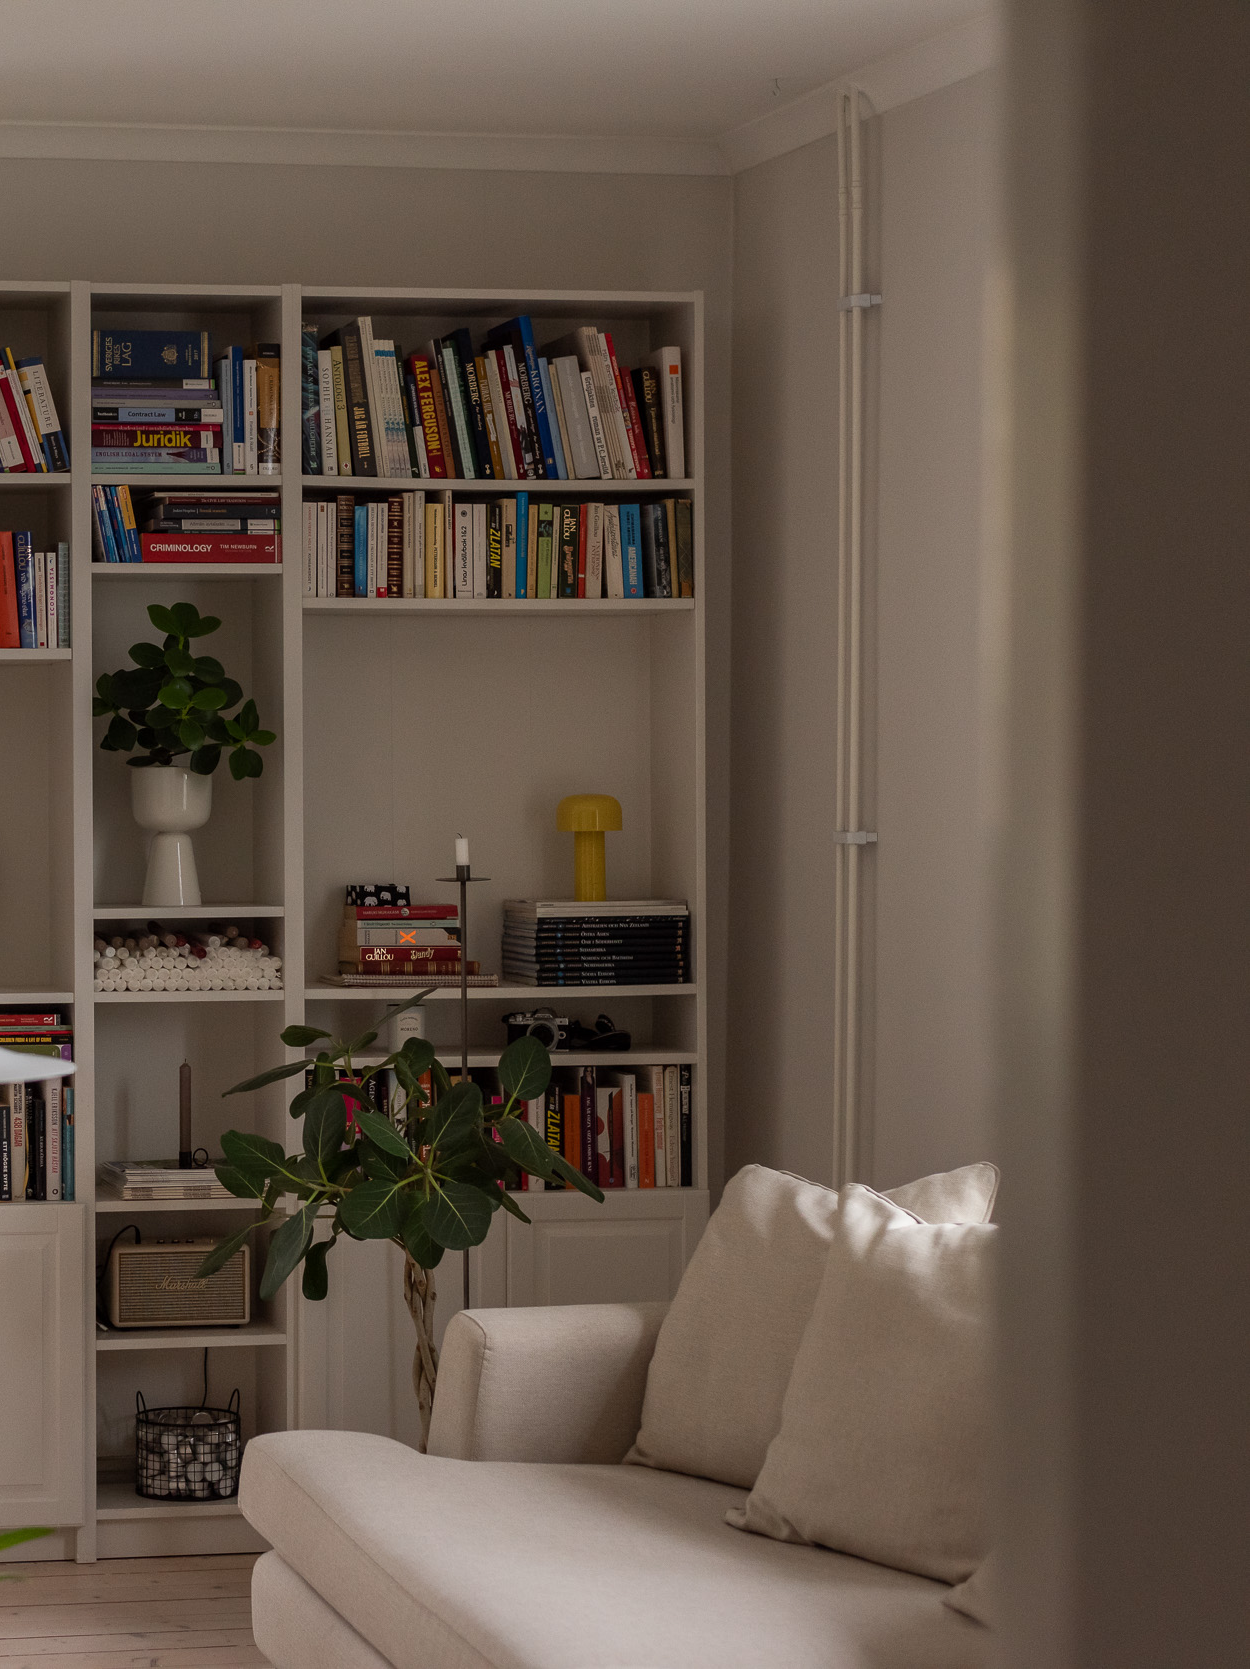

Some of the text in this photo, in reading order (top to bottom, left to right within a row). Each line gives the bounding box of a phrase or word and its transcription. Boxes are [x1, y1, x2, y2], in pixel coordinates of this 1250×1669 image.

[105, 337, 113, 372] SVERIGES
[122, 342, 132, 366] LAG
[33, 371, 52, 428] LITERATURE
[333, 360, 342, 402] ANTOLOGI
[466, 363, 479, 404] MORBERG
[517, 363, 532, 404] MORBERG
[531, 370, 545, 413] KRONAN
[604, 364, 613, 386] första
[611, 388, 620, 413] kokbok
[643, 371, 651, 402] GUILLOU
[322, 368, 333, 458] SOPHIE HANNAH
[415, 360, 440, 449] ALEX FERGUSON
[504, 391, 515, 423] MORBERG
[133, 430, 192, 447] Juridik
[353, 407, 370, 458] JAG ÄR FOTBOLL
[585, 377, 595, 408] Grisjakten
[592, 416, 600, 435] roman
[600, 455, 609, 474] Jersild
[17, 535, 26, 570] GUILLOU
[151, 544, 212, 552] CRIMINOLOGY
[490, 529, 500, 568] ZLATAN
[628, 547, 637, 585] AMERICANAH
[14, 1117, 23, 1147] 438 DAGAR
[156, 1276, 208, 1289] Marshall
